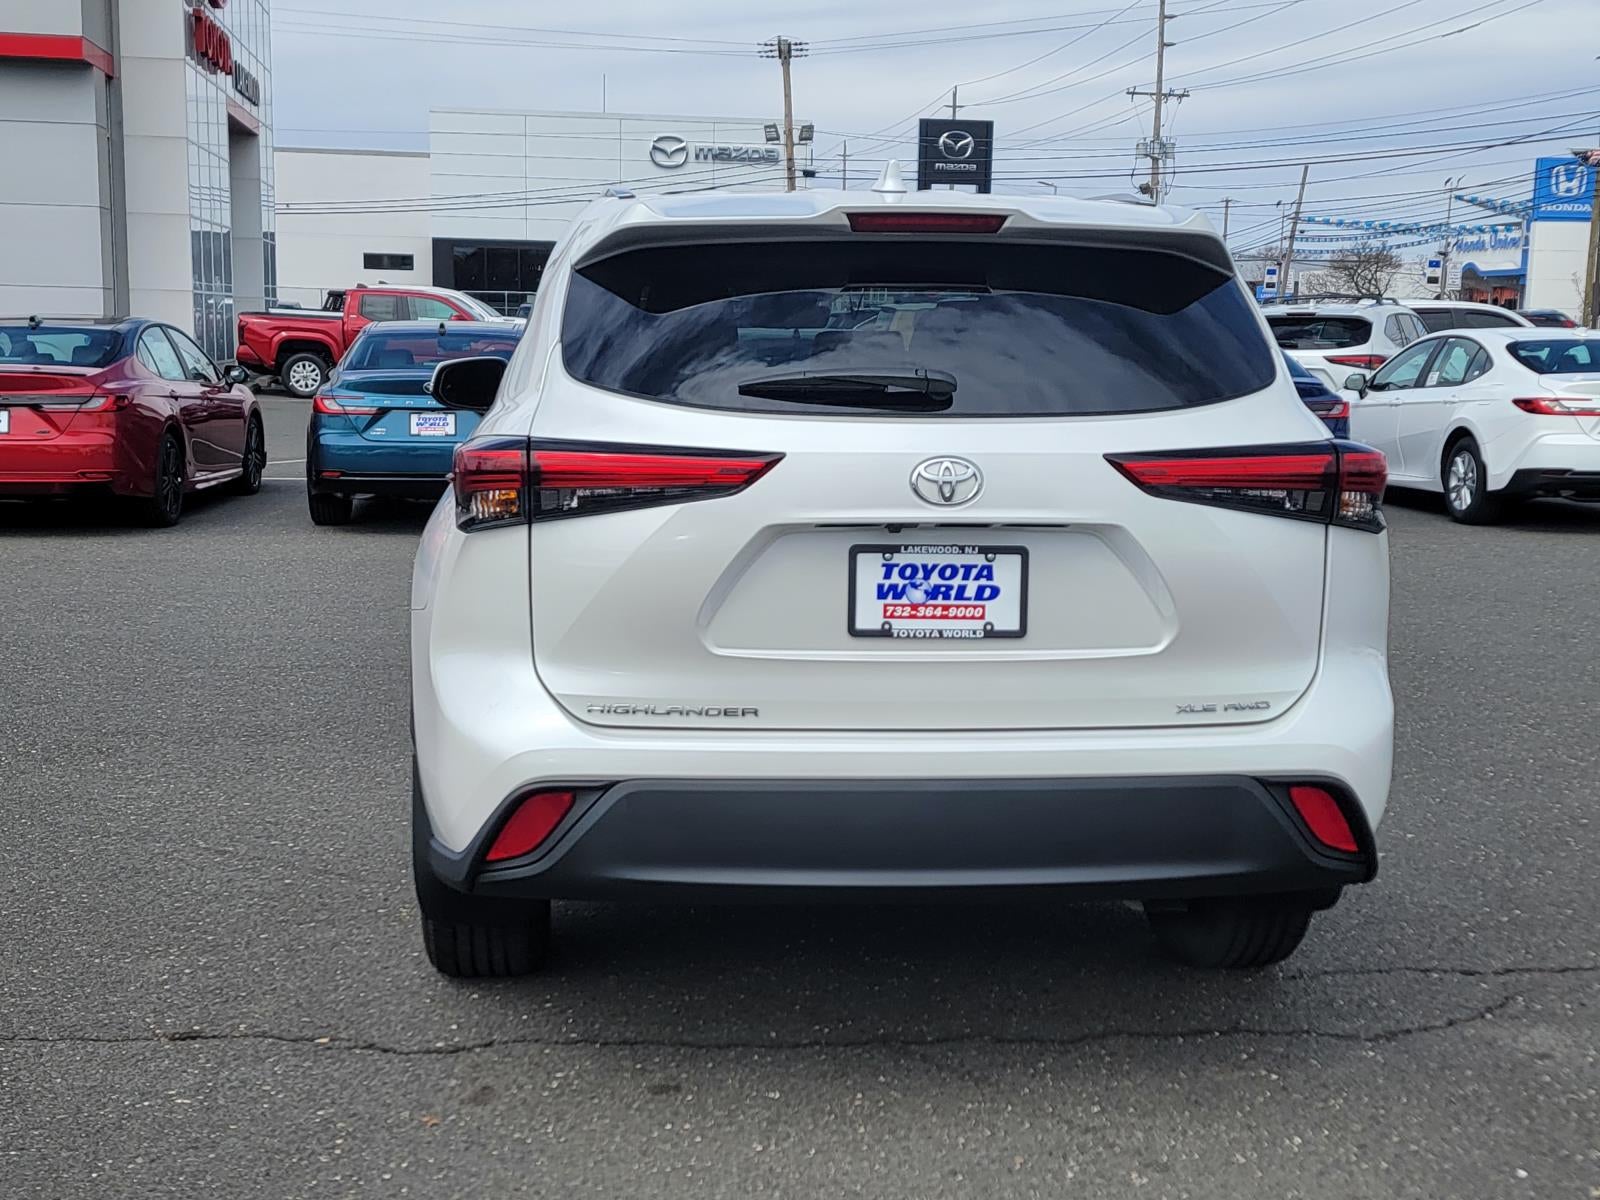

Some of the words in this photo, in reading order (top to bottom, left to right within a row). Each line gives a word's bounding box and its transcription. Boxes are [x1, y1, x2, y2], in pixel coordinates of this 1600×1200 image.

[1540, 203, 1592, 211] HONDA
[965, 546, 979, 554] NJ
[881, 563, 994, 581] TOYOTA
[885, 606, 983, 618] 732-364-9000
[892, 629, 939, 638] TOYOTA
[942, 630, 984, 638] WORLD
[586, 703, 760, 717] HIGHLANDER
[1176, 703, 1217, 714] XLE
[1223, 701, 1271, 712] AWD
